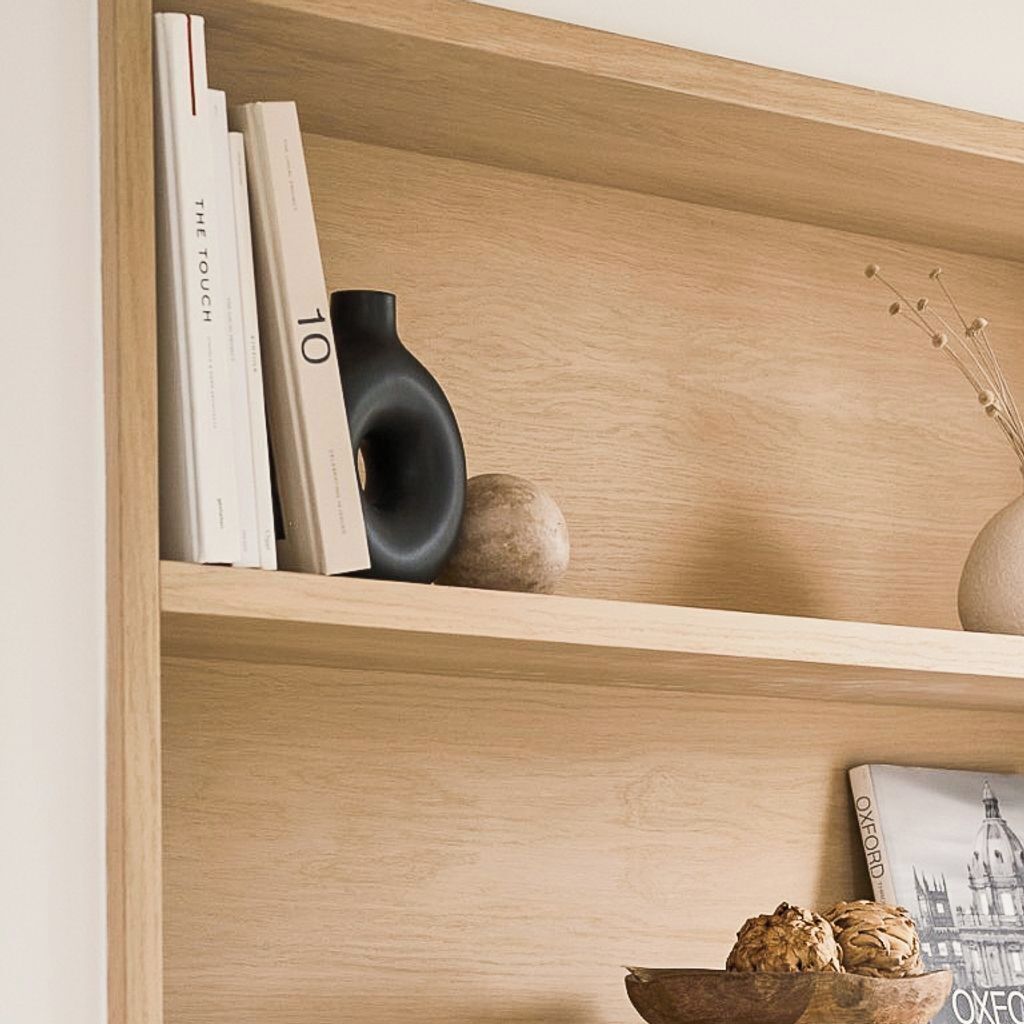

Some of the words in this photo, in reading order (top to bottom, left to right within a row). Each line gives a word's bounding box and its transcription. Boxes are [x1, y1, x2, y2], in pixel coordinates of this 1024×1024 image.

[194, 198, 207, 237] THE
[197, 247, 212, 323] TOUCH
[296, 307, 332, 364] 10
[855, 795, 885, 880] OXFORD
